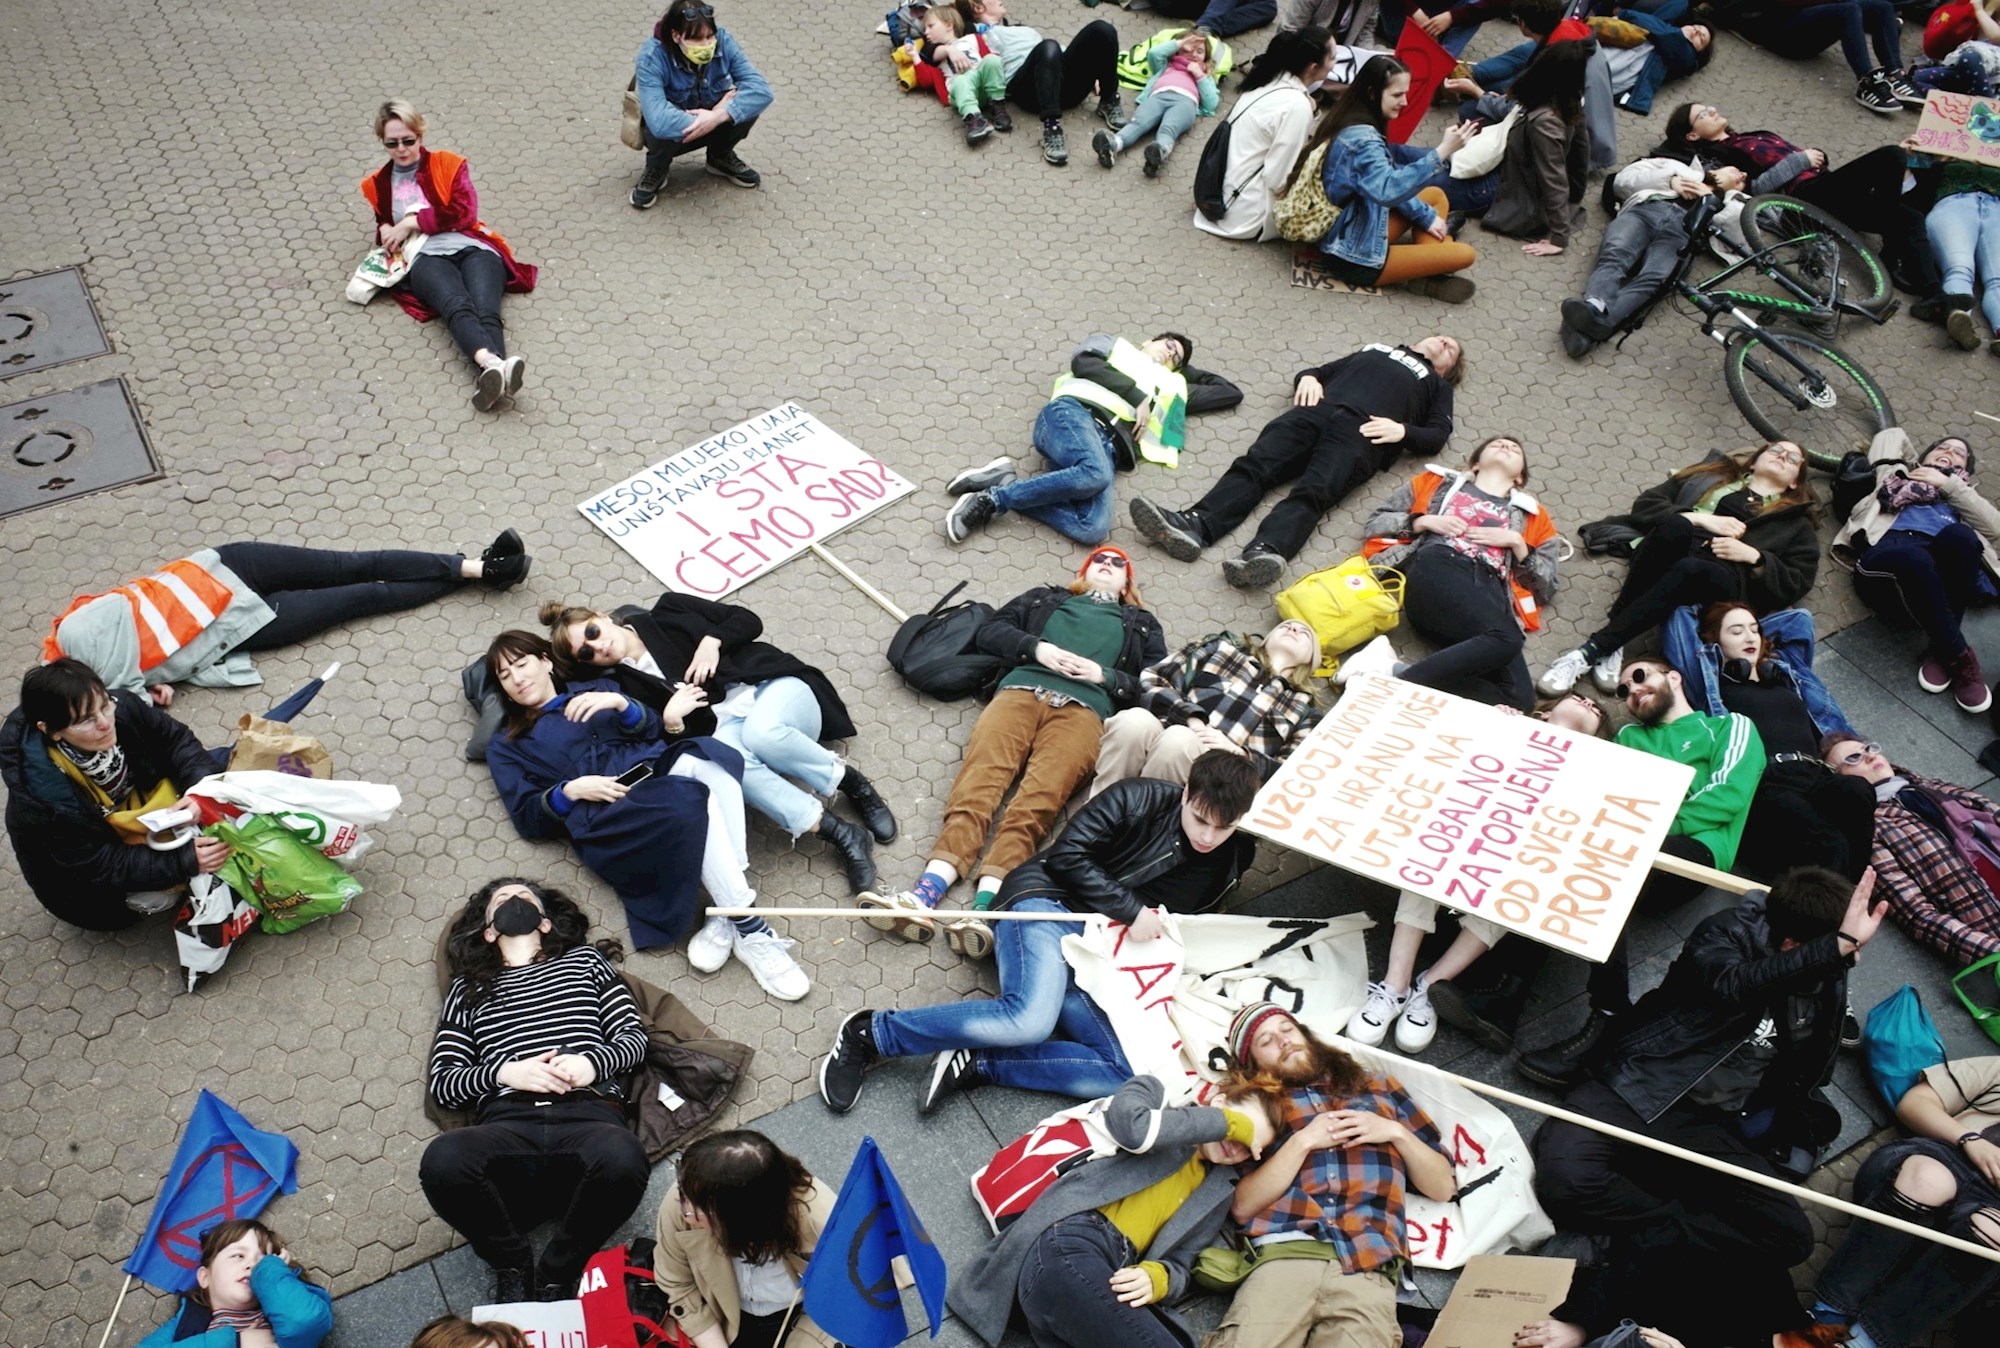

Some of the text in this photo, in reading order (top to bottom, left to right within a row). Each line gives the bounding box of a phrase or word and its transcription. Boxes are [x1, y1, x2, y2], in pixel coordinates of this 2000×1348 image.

[1293, 269, 1335, 290] SAM
[586, 403, 807, 521] MESO, MLIJEKO I JAJA
[607, 421, 816, 537] UNIŠTAVAJU PLANET
[676, 454, 828, 536] I ŠTA
[805, 459, 902, 518] SAD?
[1253, 747, 1342, 831] UZGOJ
[1315, 676, 1404, 751] ŽIVOTINJA
[1303, 690, 1448, 852] ZA HRANU VIŠE
[1351, 732, 1474, 869] UTJEČE NA
[1399, 753, 1505, 887] GLOBALNO
[1445, 729, 1573, 909] ZATOPLJENJE
[1494, 805, 1581, 924] OD SVEG
[1540, 793, 1661, 945] PROMETA
